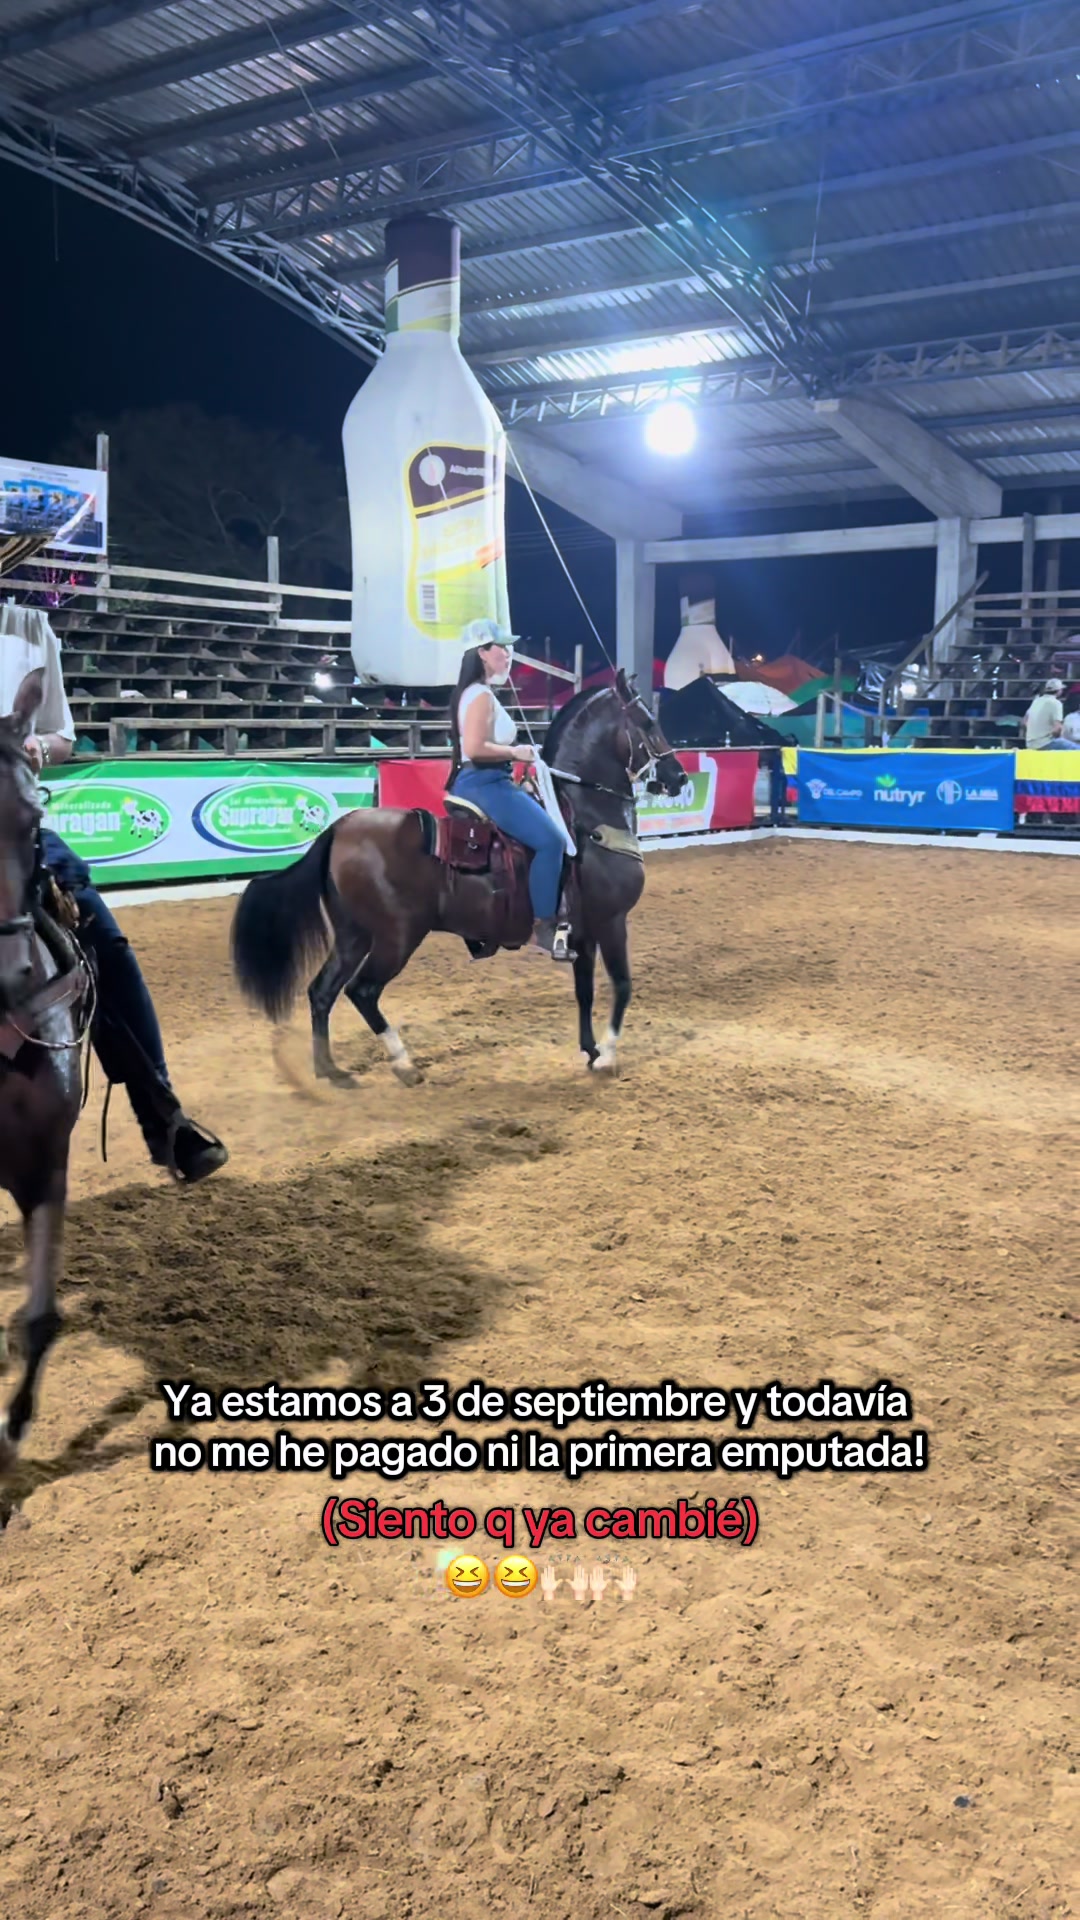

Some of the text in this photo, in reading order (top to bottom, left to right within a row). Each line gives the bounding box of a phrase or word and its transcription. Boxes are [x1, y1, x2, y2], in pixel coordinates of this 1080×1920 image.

[874, 786, 926, 807] nutryr
[44, 811, 121, 836] pragan
[218, 804, 294, 828] Supragan
